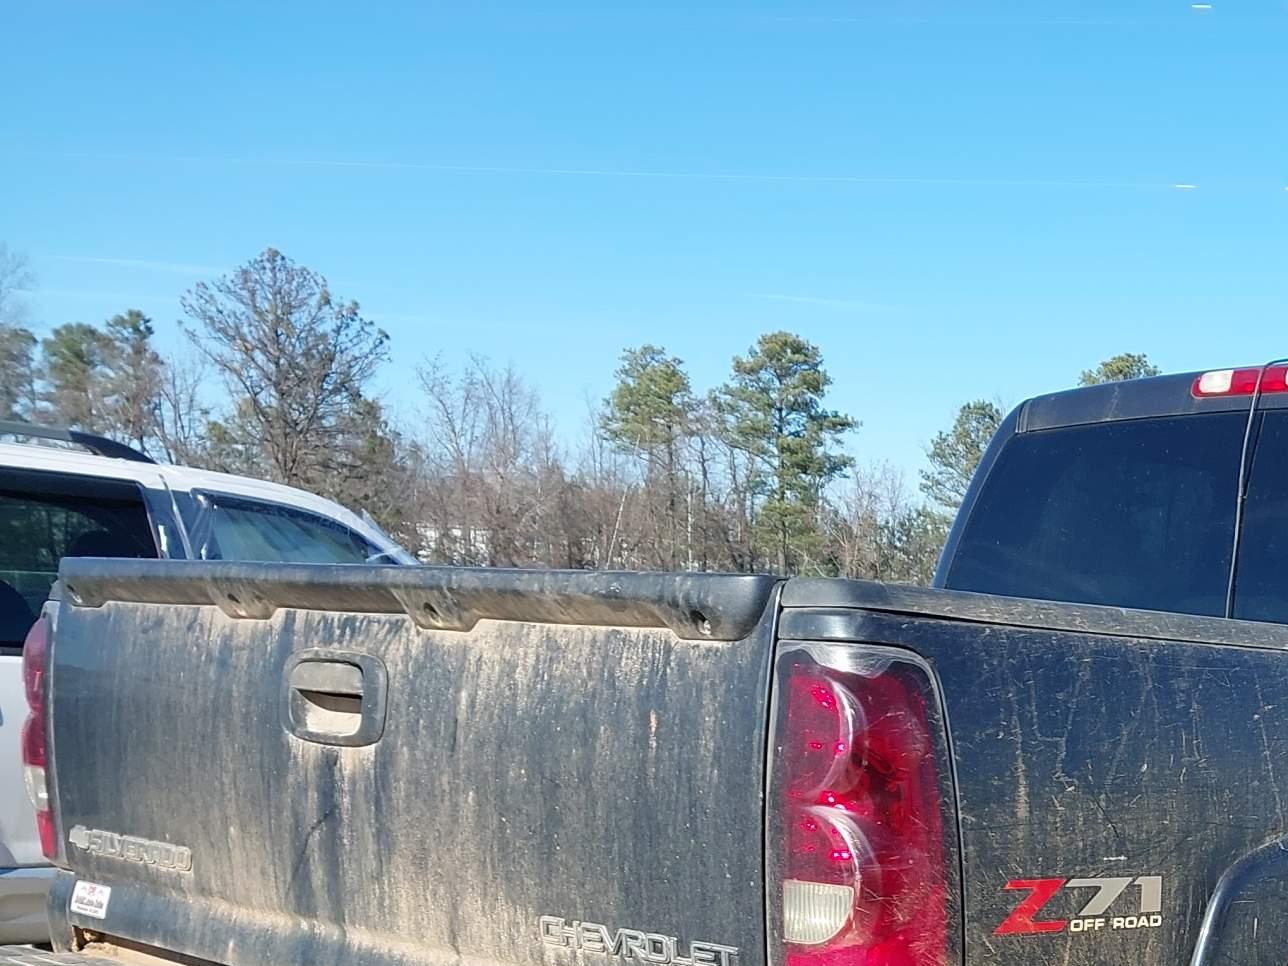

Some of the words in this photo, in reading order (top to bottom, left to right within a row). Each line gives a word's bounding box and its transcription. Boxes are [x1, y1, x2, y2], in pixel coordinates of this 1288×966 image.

[88, 828, 193, 872] SILVERADO
[992, 874, 1163, 937] Z71
[1070, 918, 1106, 933] OFF
[1112, 915, 1163, 930] ROAD
